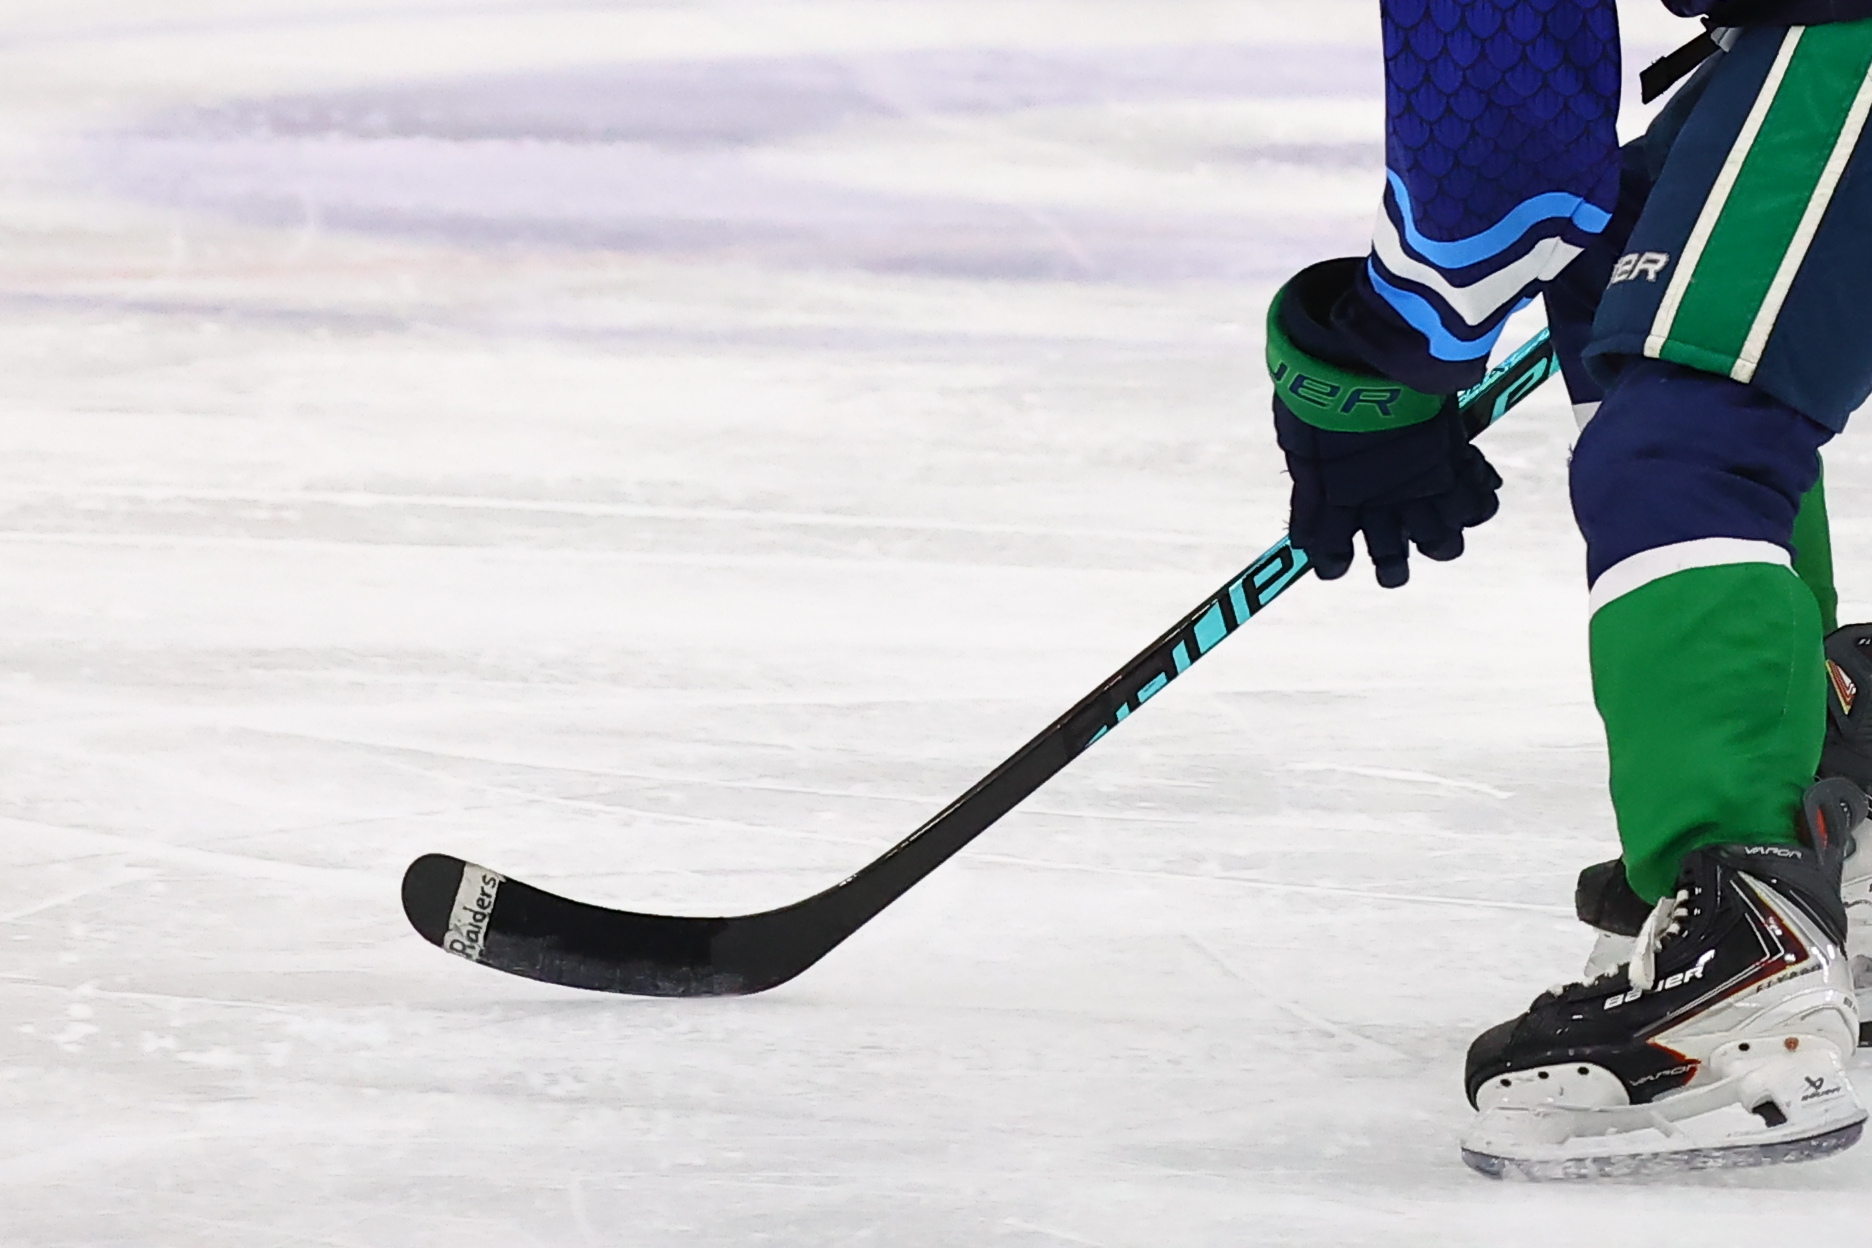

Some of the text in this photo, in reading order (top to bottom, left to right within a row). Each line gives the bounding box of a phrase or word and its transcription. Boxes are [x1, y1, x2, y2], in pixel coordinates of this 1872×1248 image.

[1606, 251, 1670, 290] ER
[1744, 846, 1803, 860] VAPOR
[448, 874, 498, 960] Raiders
